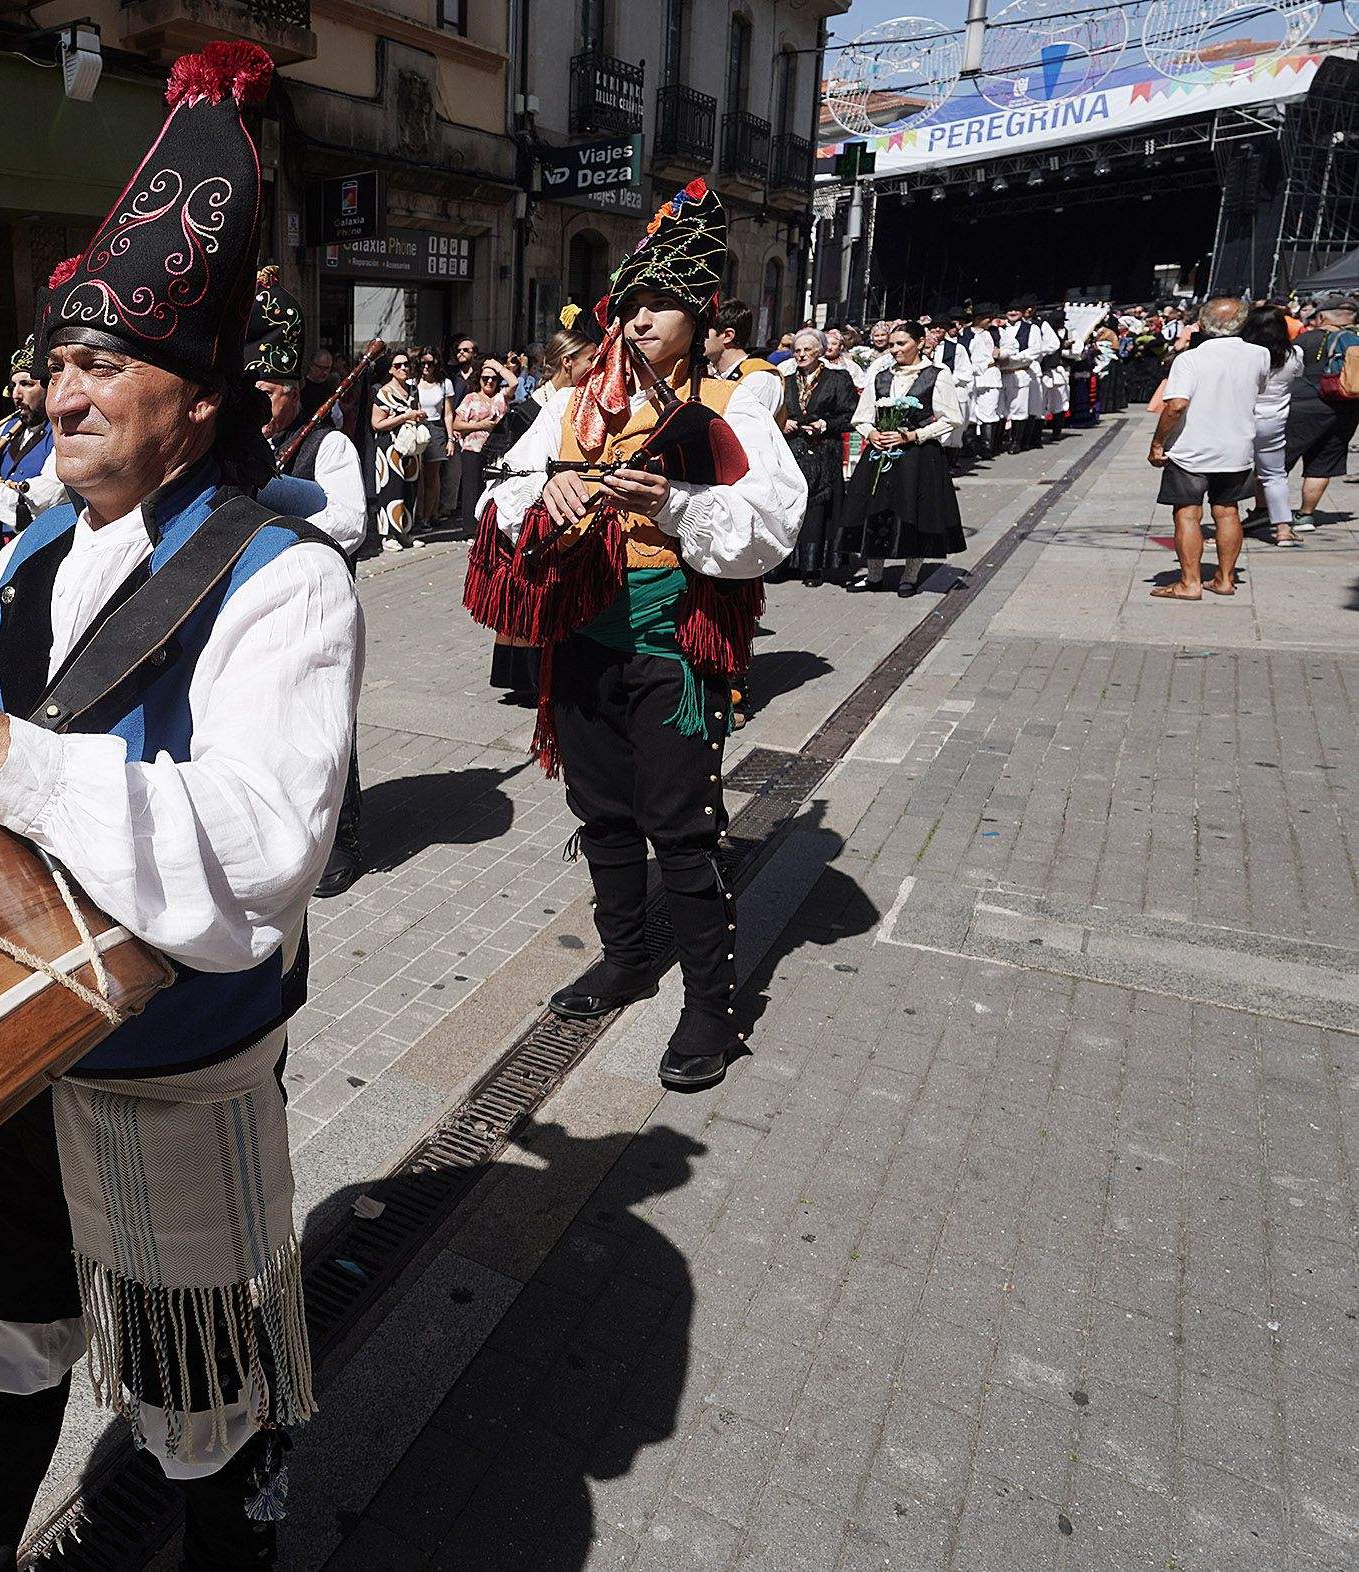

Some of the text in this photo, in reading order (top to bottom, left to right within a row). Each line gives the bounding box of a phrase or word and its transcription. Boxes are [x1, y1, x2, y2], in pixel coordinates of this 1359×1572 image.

[927, 94, 1109, 152] PEREGRINA
[579, 145, 634, 165] Viajes
[577, 166, 633, 188] Deza
[333, 216, 365, 228] Galaxia
[388, 236, 418, 257] Phone
